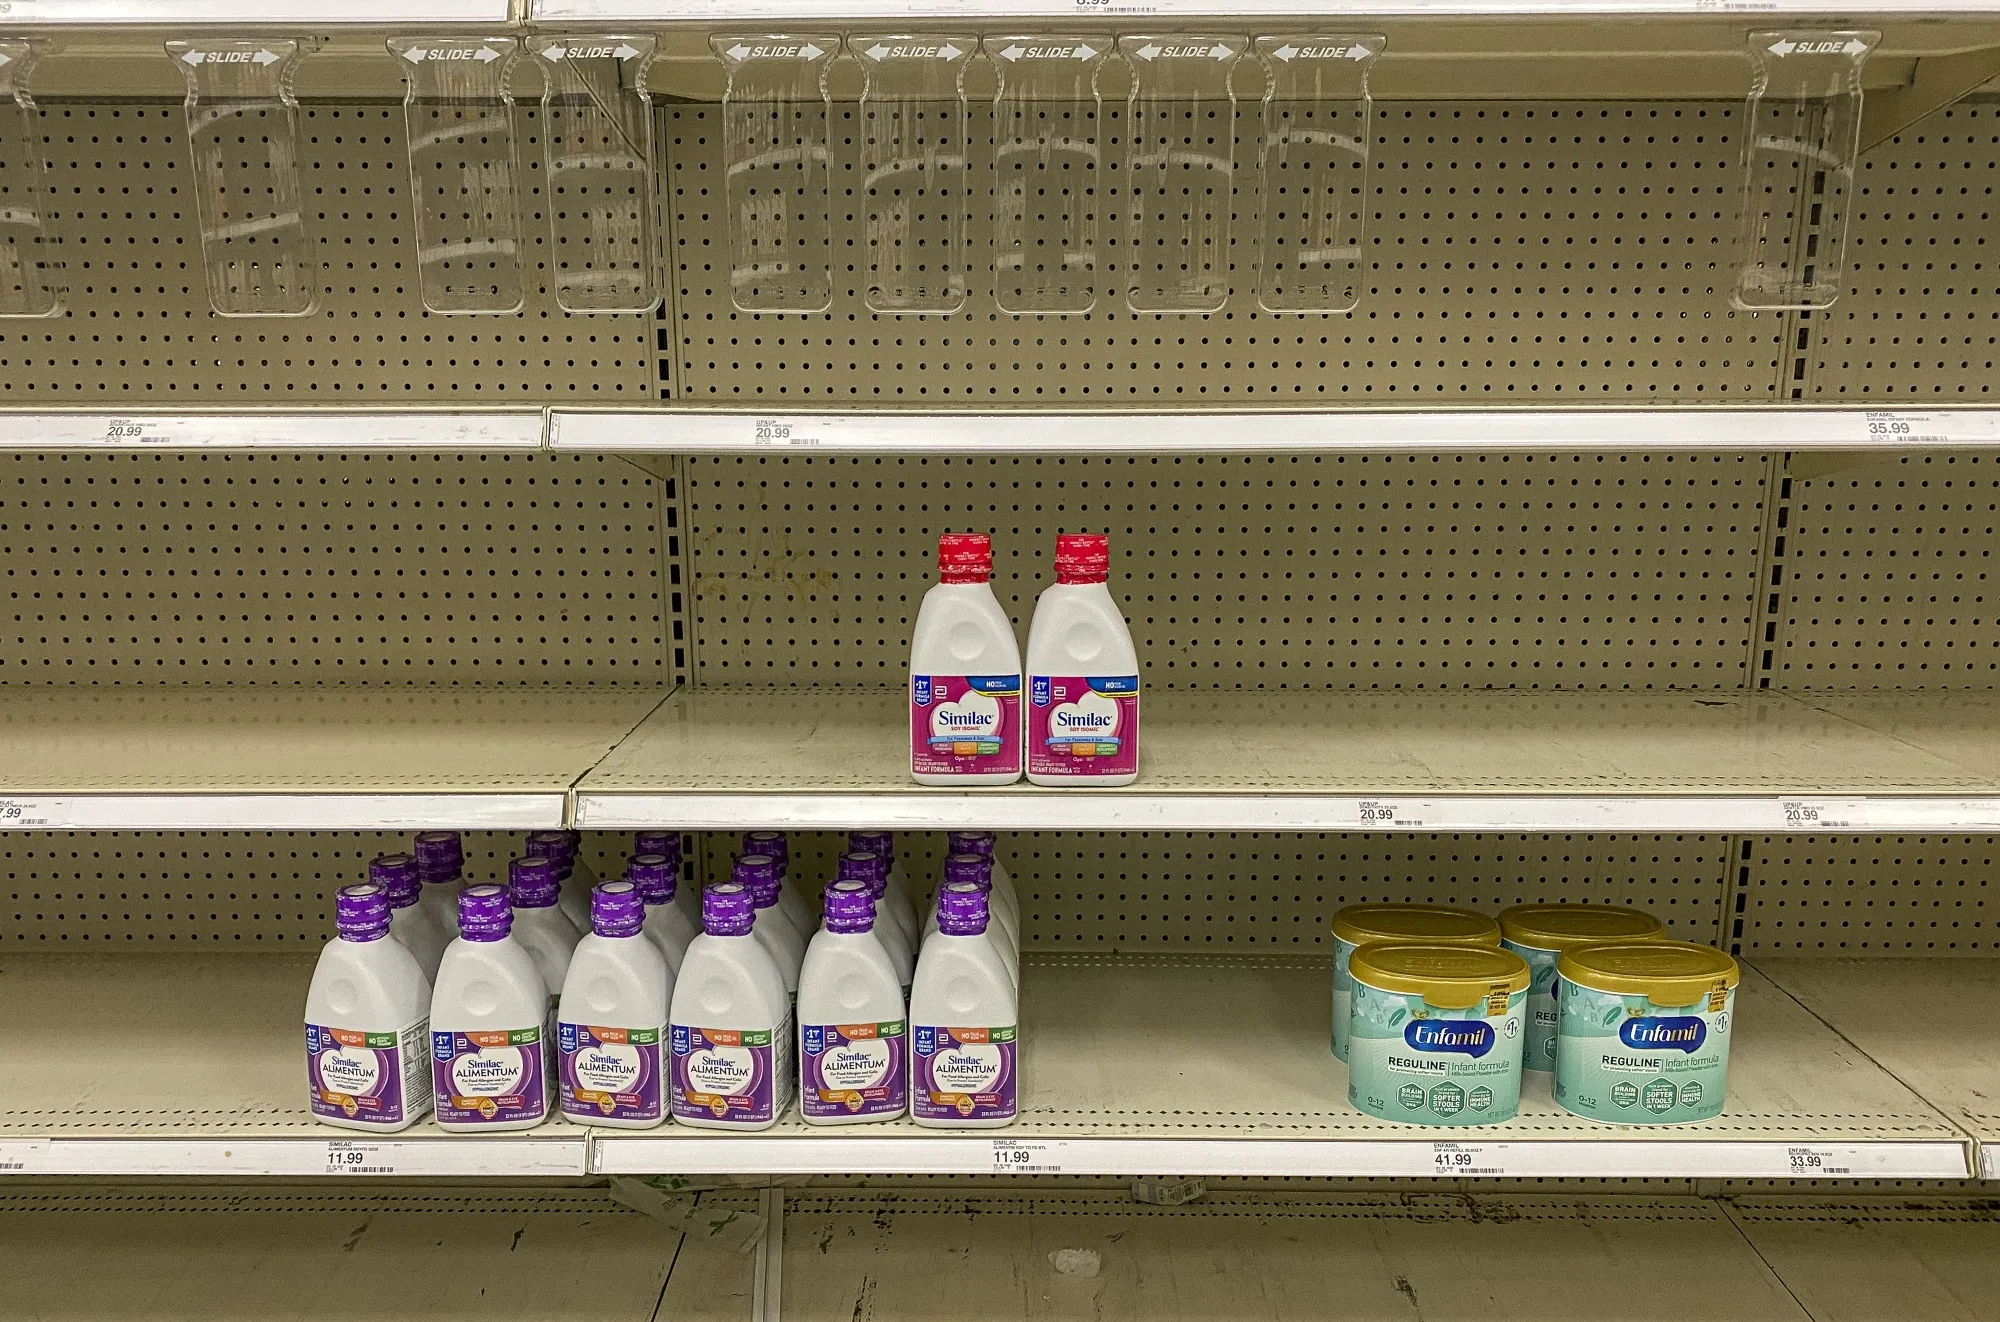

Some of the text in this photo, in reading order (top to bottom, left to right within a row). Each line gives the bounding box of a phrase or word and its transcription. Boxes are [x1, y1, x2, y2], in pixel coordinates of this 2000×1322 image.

[566, 47, 613, 59] SLIDE
[752, 46, 795, 58] SLIDE
[888, 46, 932, 58] SLIDE
[1029, 47, 1073, 58] SLIDE
[1163, 46, 1207, 58] SLIDE
[1300, 47, 1343, 58] SLIDE
[1797, 41, 1843, 54] SLIDE
[207, 51, 252, 63] SLIDE
[428, 49, 472, 60] SLIDE
[107, 427, 142, 436] 20.99
[756, 428, 789, 438] 20.99
[1869, 423, 1909, 433] 35.99
[939, 711, 992, 725] Similac
[1057, 712, 1110, 726] Similac
[1360, 810, 1393, 819] 20.99
[1785, 810, 1818, 820] 20.99
[1415, 1026, 1486, 1045] Enfamil
[1630, 1023, 1698, 1042] Enfamil
[332, 1056, 359, 1067] Similac
[590, 1054, 620, 1064] Similac
[702, 1056, 733, 1067] Similac
[837, 1053, 869, 1062] Similac
[948, 1056, 980, 1065] Similac
[1388, 1056, 1446, 1070] REGULINE
[1602, 1055, 1660, 1067] REGULINE
[1666, 1054, 1719, 1067] Infant formula
[468, 1060, 501, 1068] Similac
[578, 1062, 634, 1074] ALIMENTUM
[824, 1061, 884, 1070] ALIMENTUM
[936, 1065, 996, 1074] ALIMENTUM
[1452, 1059, 1509, 1071] Infant formula
[323, 1064, 374, 1077] ALIMENTUM
[456, 1068, 518, 1077] ALIMENTUM
[691, 1065, 748, 1076] ALIMENTUM
[1368, 1096, 1384, 1107] 0-12
[1578, 1095, 1596, 1105] 0-12
[328, 1153, 363, 1164] 11.99
[994, 1151, 1029, 1162] 11.99
[1435, 1154, 1471, 1165] 41.99
[1790, 1156, 1821, 1166] 33.99
